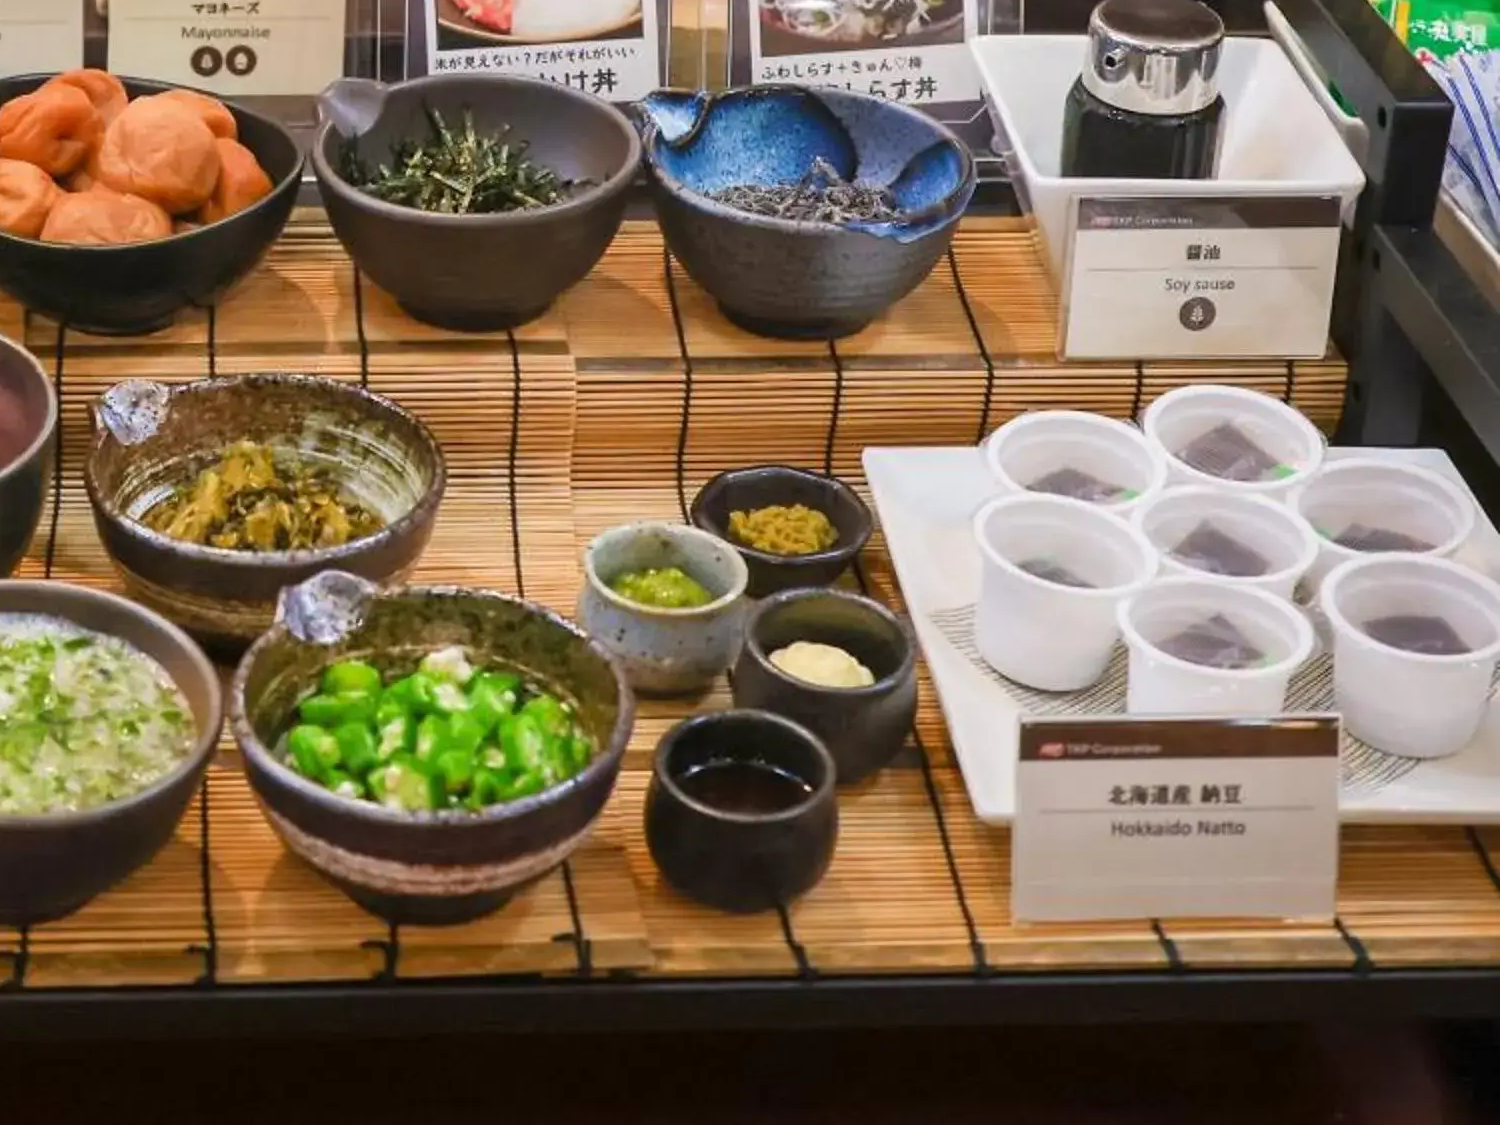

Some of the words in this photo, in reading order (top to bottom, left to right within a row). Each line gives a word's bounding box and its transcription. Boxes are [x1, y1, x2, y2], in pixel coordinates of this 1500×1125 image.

[193, 3, 260, 14] マヨネーズ
[181, 28, 271, 39] Mayonnaise
[1165, 279, 1190, 293] Soy
[1110, 785, 1190, 805] 北海道産
[1201, 785, 1242, 804] 納豆
[1111, 823, 1192, 837] Hokkaido
[1197, 821, 1246, 836] Natto
